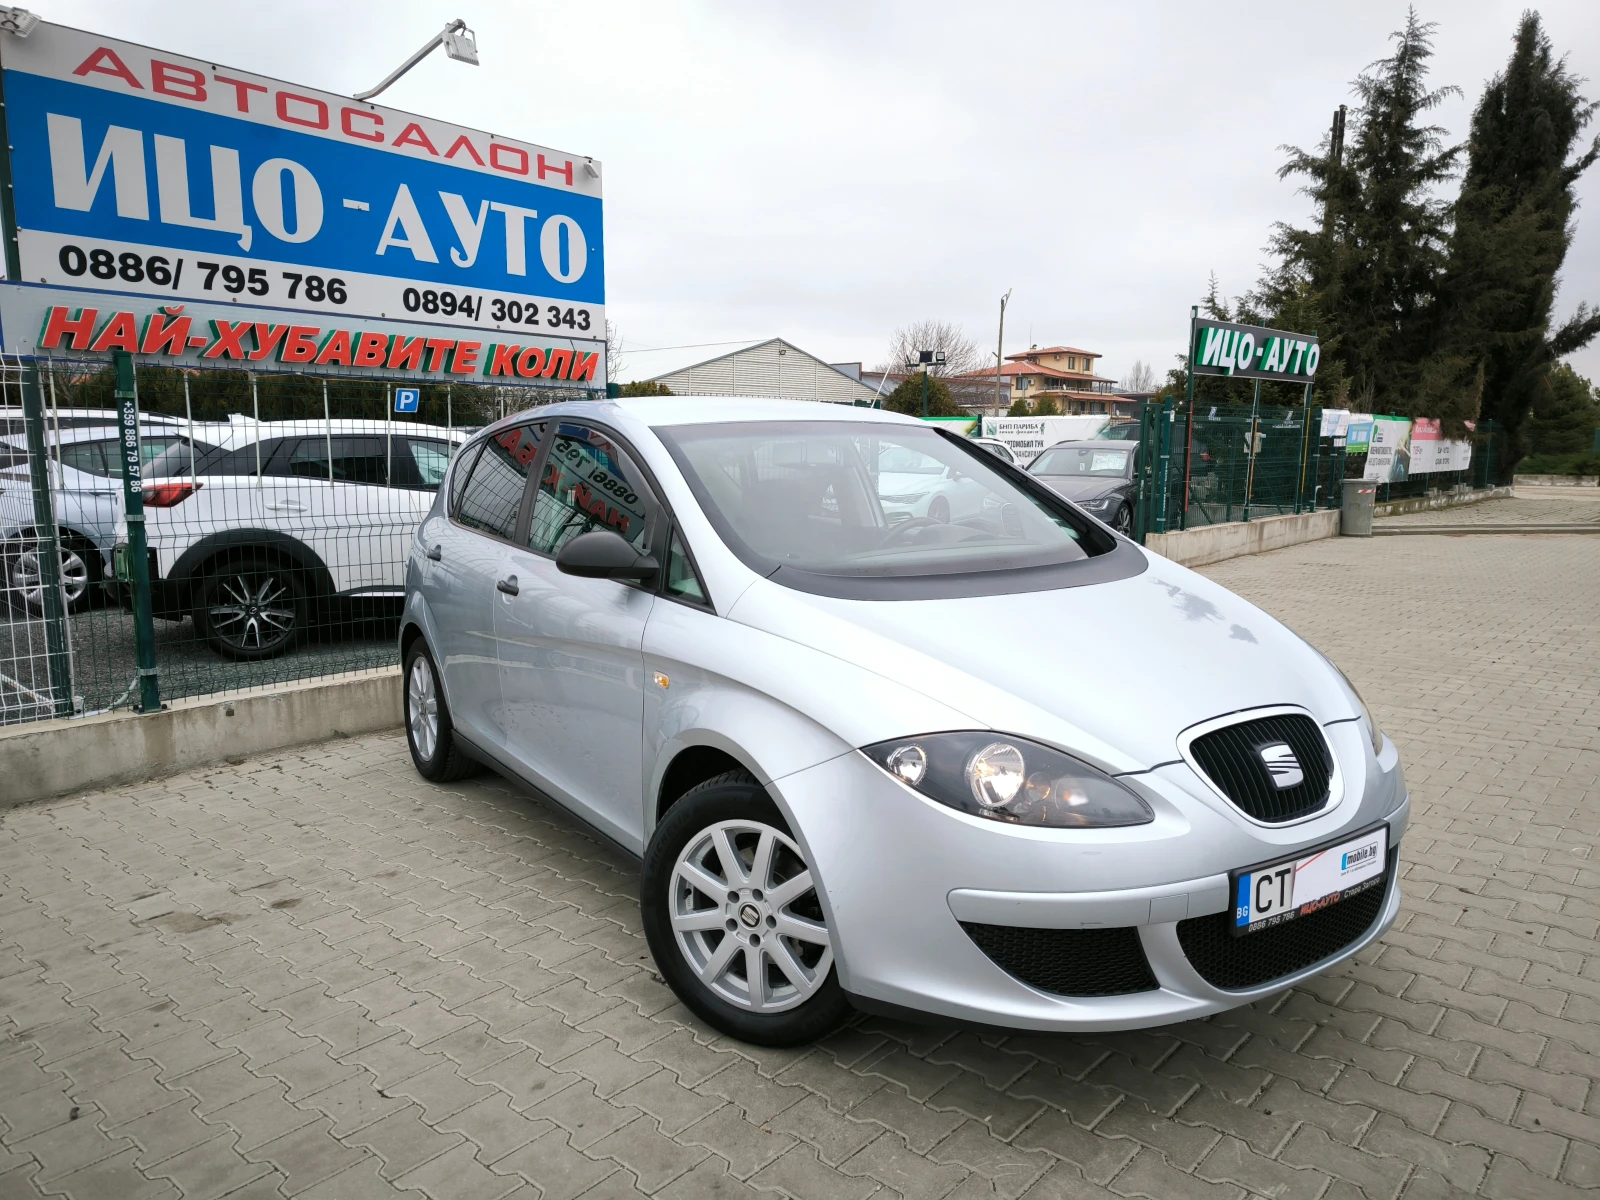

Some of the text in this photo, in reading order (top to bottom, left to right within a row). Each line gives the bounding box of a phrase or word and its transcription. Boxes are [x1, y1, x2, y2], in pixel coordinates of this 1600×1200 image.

[72, 46, 573, 187] АВТОСАЛОН
[58, 245, 348, 305] 0886/ 795 786
[402, 287, 591, 331] 0894/ 302 343
[40, 304, 600, 382] НАЙ-ХУБАВИТЕ КОЛИ
[1199, 326, 1320, 376] ИЦО-АУТО
[399, 391, 415, 410] P
[123, 401, 142, 493] +359 886 79 57 86
[1346, 845, 1378, 866] mobile.bg
[1236, 905, 1249, 919] BG
[1255, 868, 1291, 914] CT
[1248, 920, 1267, 933] 0886
[1267, 915, 1281, 928] 795
[1281, 910, 1296, 922] 786
